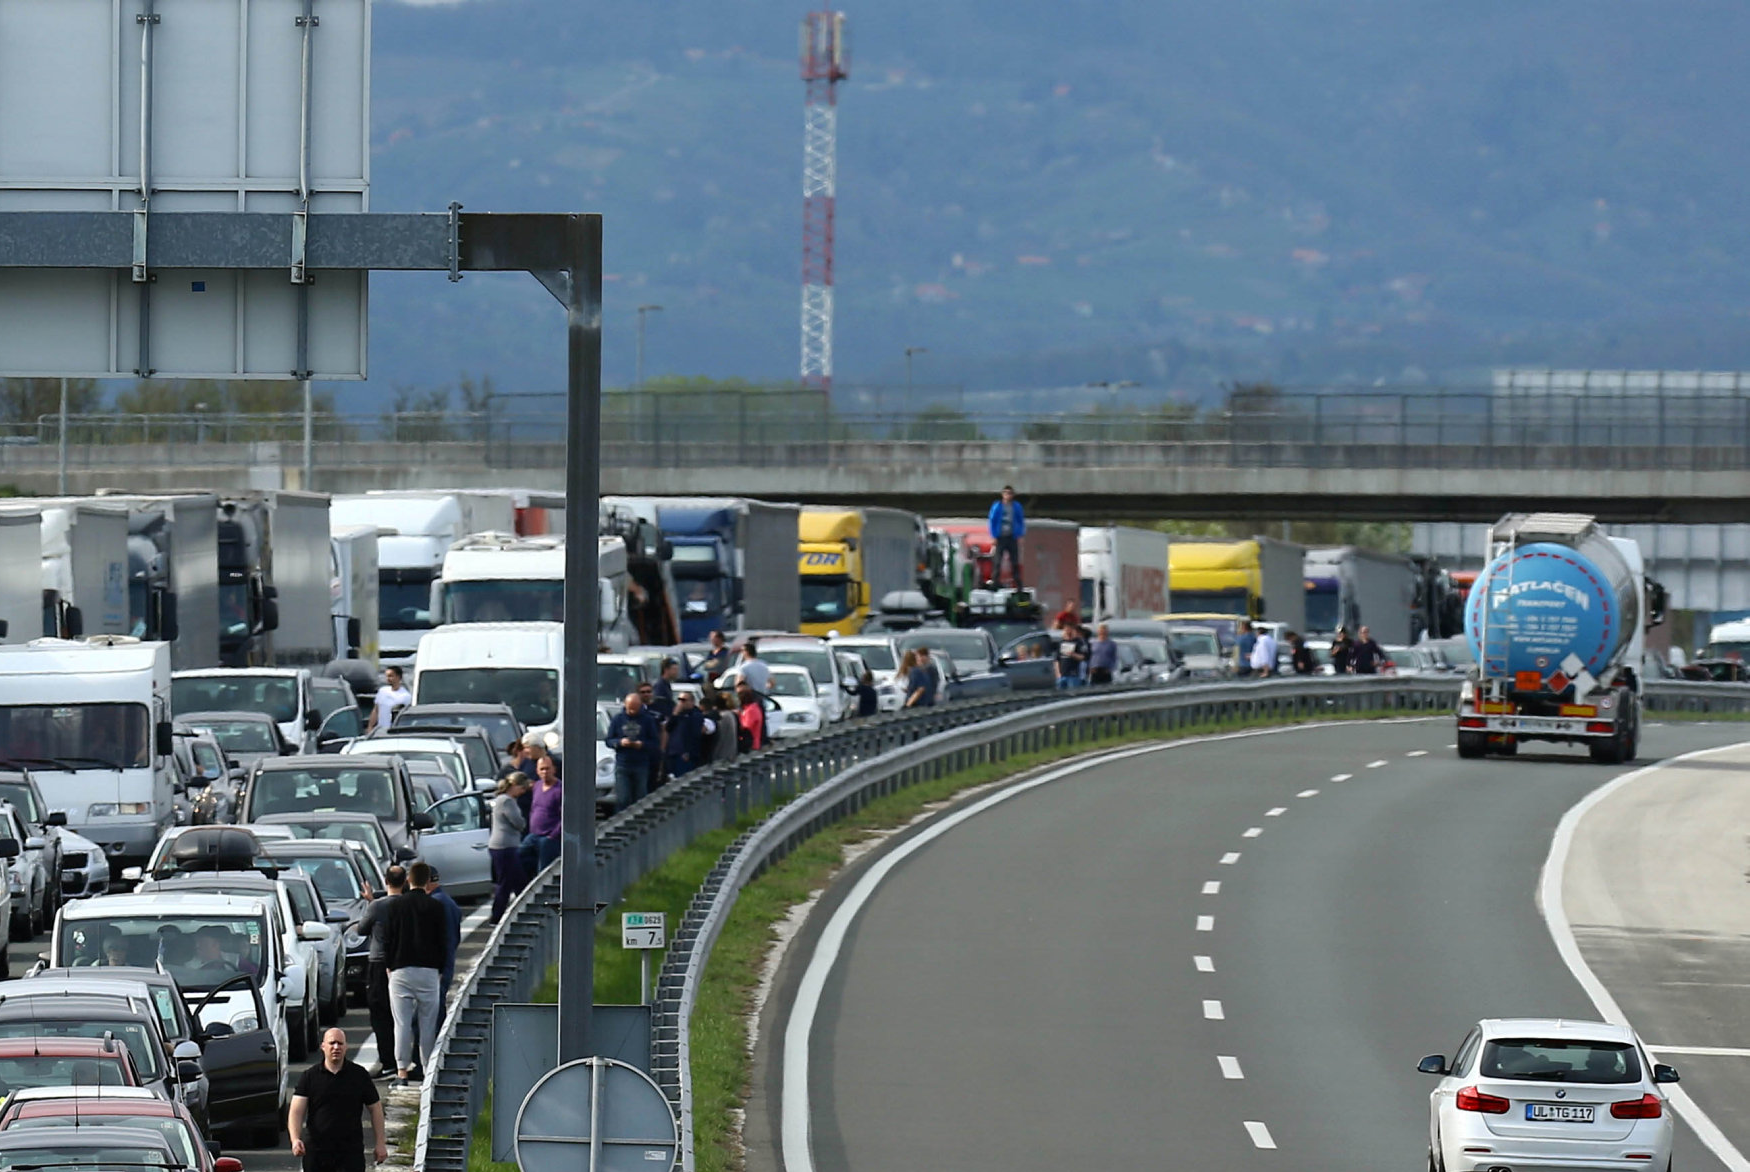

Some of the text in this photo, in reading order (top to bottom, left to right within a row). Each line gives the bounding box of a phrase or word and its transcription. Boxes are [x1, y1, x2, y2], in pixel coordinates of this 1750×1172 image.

[1533, 1106, 1593, 1119] UL TG 117
